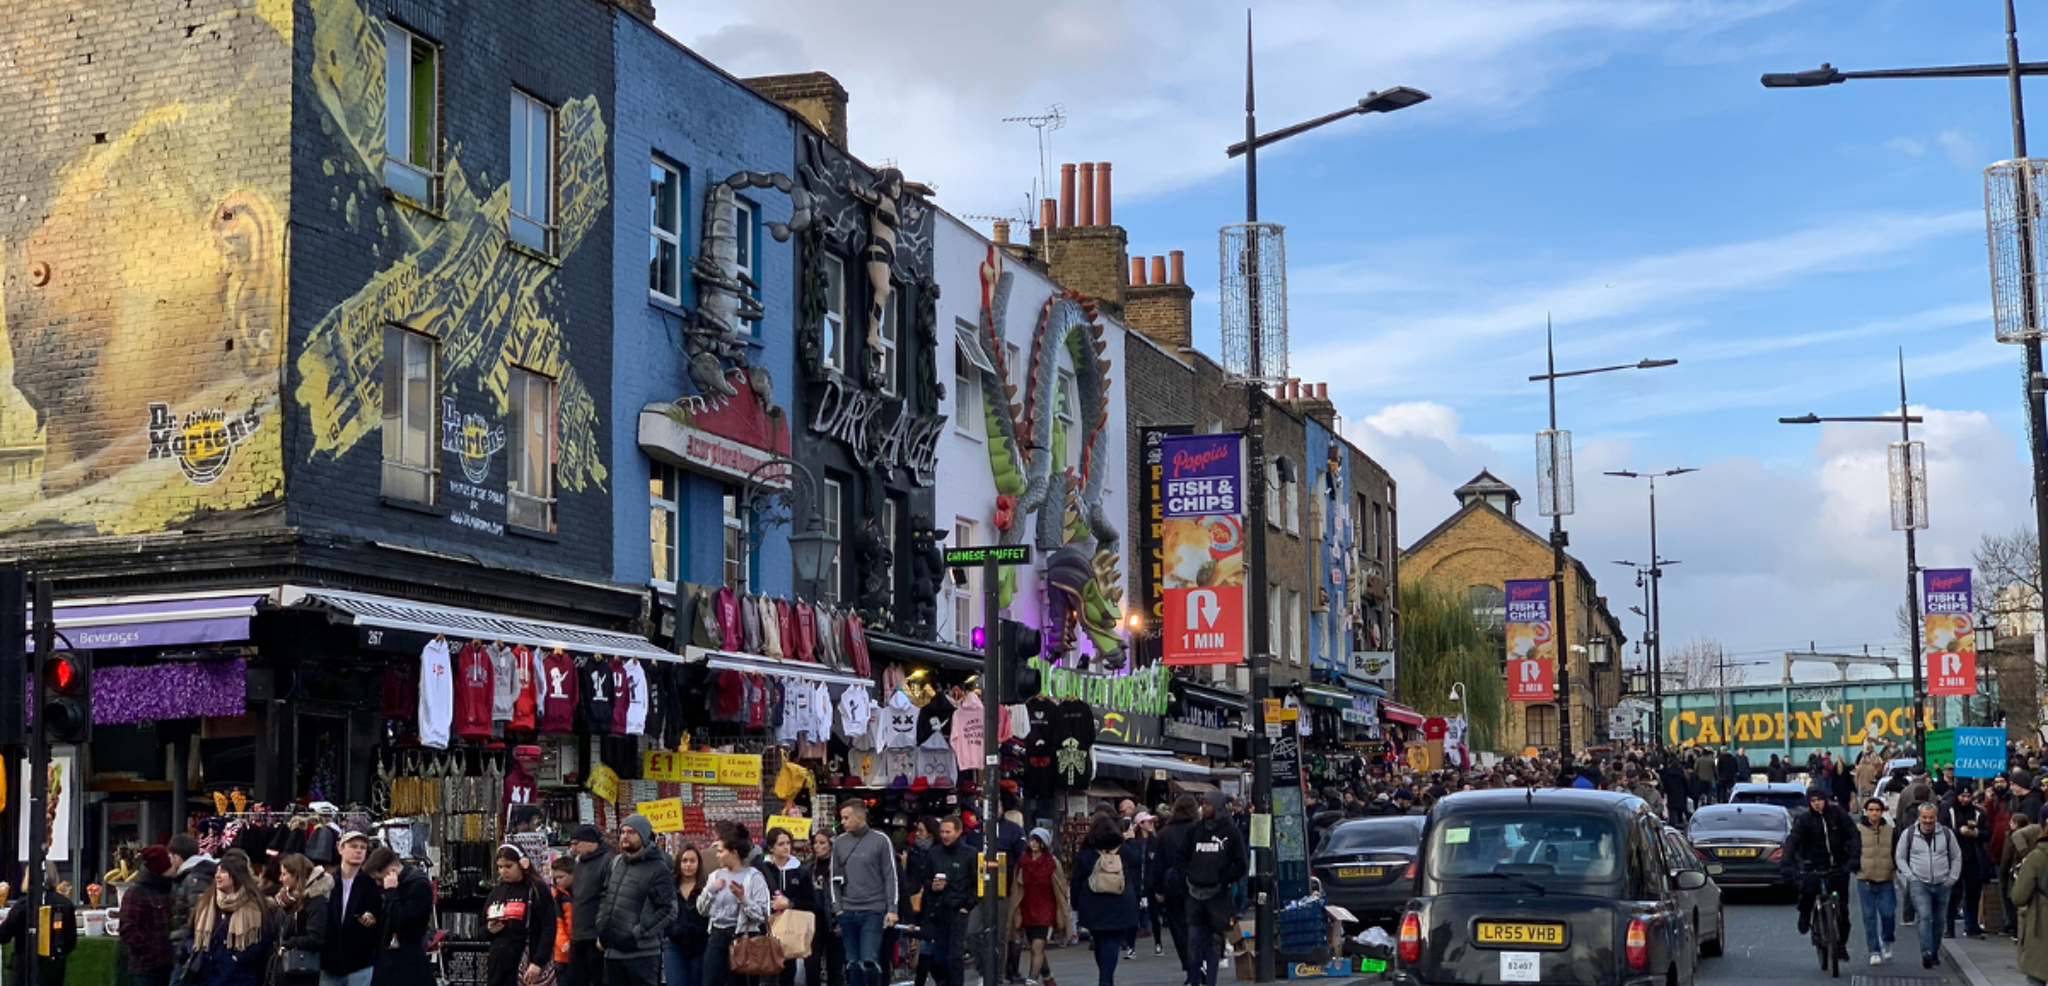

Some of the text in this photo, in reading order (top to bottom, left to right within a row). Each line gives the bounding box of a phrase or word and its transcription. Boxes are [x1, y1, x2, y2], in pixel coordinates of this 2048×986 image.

[813, 374, 884, 467] DARK
[148, 407, 261, 459] Martens
[442, 422, 506, 454] Martens
[1173, 443, 1228, 478] Poppies
[1168, 479, 1234, 497] FISH &
[1168, 495, 1235, 513] CHIPS
[947, 550, 986, 561] CHINESE
[1930, 574, 1964, 592] Poppies
[1928, 593, 1967, 603] FISH &
[1509, 602, 1546, 612] FISH &
[1928, 602, 1968, 612] CHIPS
[1509, 611, 1547, 620] CHIPS
[79, 630, 139, 645] Beverages
[368, 631, 384, 645] 267
[1182, 633, 1225, 649] 1 MIN
[1055, 668, 1082, 701] CAN
[1087, 676, 1110, 708] EAT
[1519, 684, 1543, 693] 2 MIN
[1939, 677, 1965, 687] 2 MIN
[1670, 711, 1824, 746] CAMDEN
[1958, 735, 2003, 746] MONEY
[650, 753, 673, 772] £1
[1955, 757, 2005, 770] CHANGE
[730, 769, 742, 777] for
[745, 770, 757, 778] £5
[650, 811, 663, 820] for
[1196, 842, 1219, 852] PUMA
[1484, 925, 1556, 941] LR55 VHB
